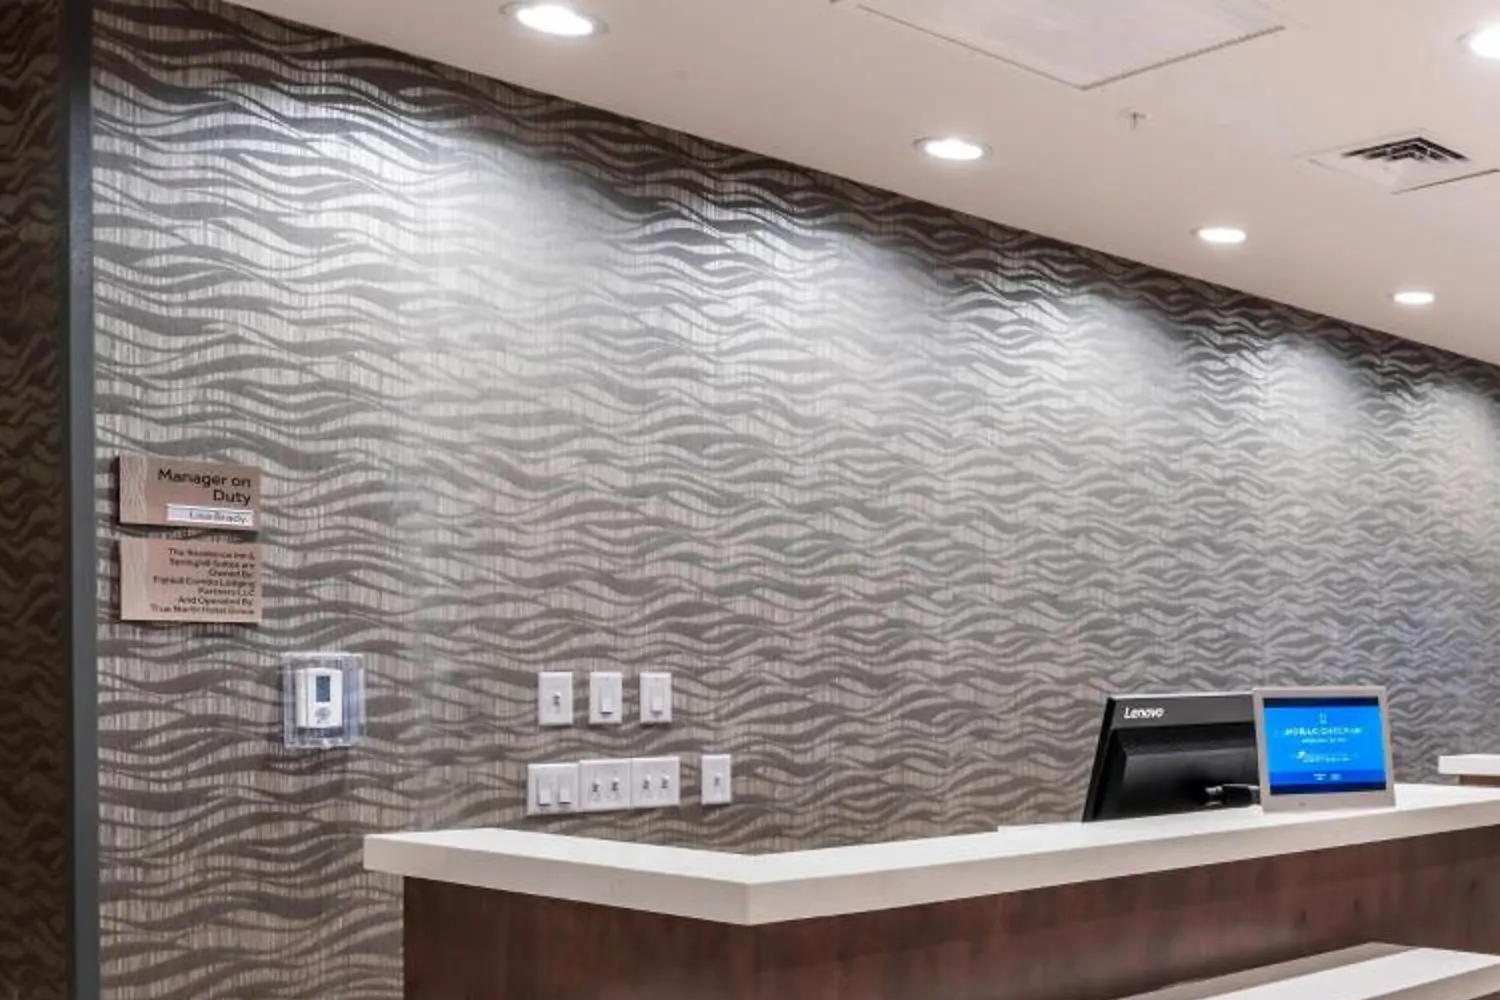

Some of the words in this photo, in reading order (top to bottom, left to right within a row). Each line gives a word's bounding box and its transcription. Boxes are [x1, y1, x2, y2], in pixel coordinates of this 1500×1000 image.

[157, 468, 228, 489] Manager
[231, 477, 252, 488] on
[213, 489, 252, 507] Duty
[1123, 706, 1165, 719] Lenovo
